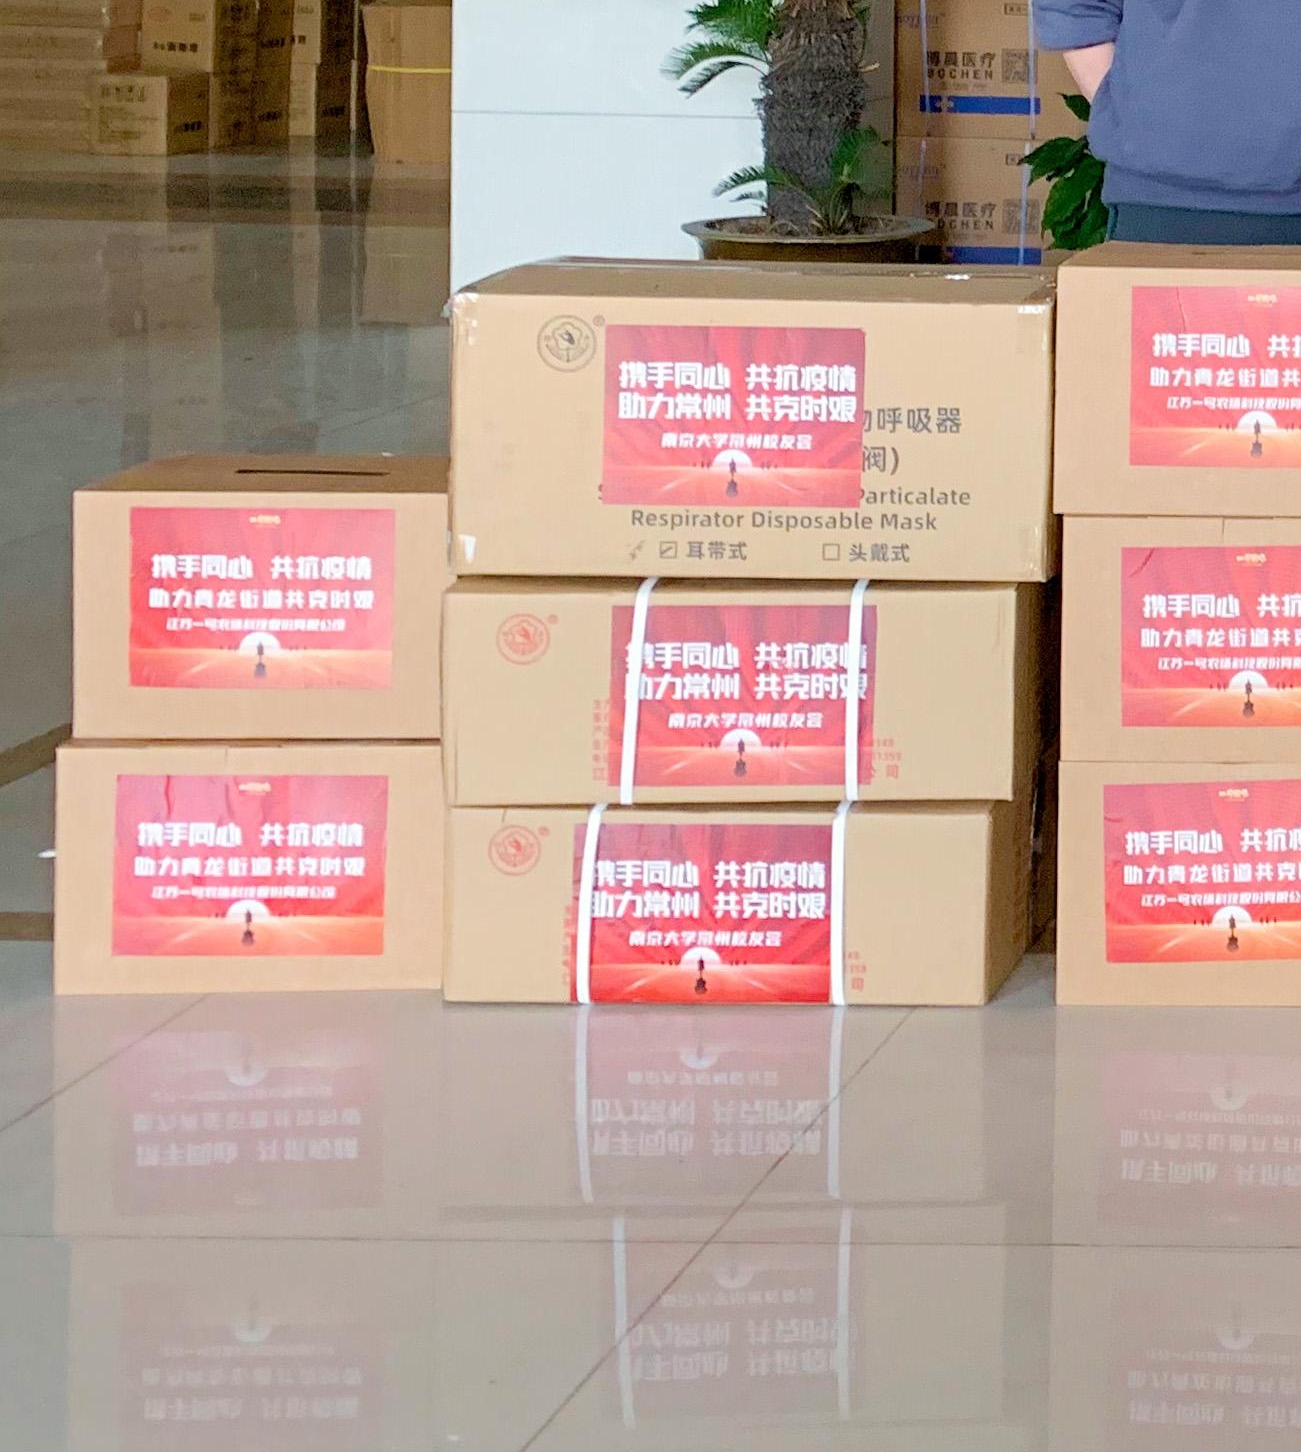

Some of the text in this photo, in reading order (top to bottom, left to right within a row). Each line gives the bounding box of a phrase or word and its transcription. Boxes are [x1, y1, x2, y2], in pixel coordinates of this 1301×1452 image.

[936, 219, 994, 230] OCHEN
[1152, 333, 1250, 358] 携手同心
[619, 361, 856, 392] 携手同心 共抗疫情
[618, 392, 857, 422] 助力常州 共克时艰
[631, 509, 937, 533] Respirator Disposable Mask
[686, 541, 748, 561] 耳带式
[151, 554, 372, 580] 携手同心 共抗疫情
[1142, 594, 1240, 618] 携手同心
[137, 821, 363, 847] 携手同心 共抗疫情
[1125, 830, 1223, 855] 携手同心
[713, 861, 825, 888] 共抗疫情
[713, 891, 826, 919] 共克时艰
